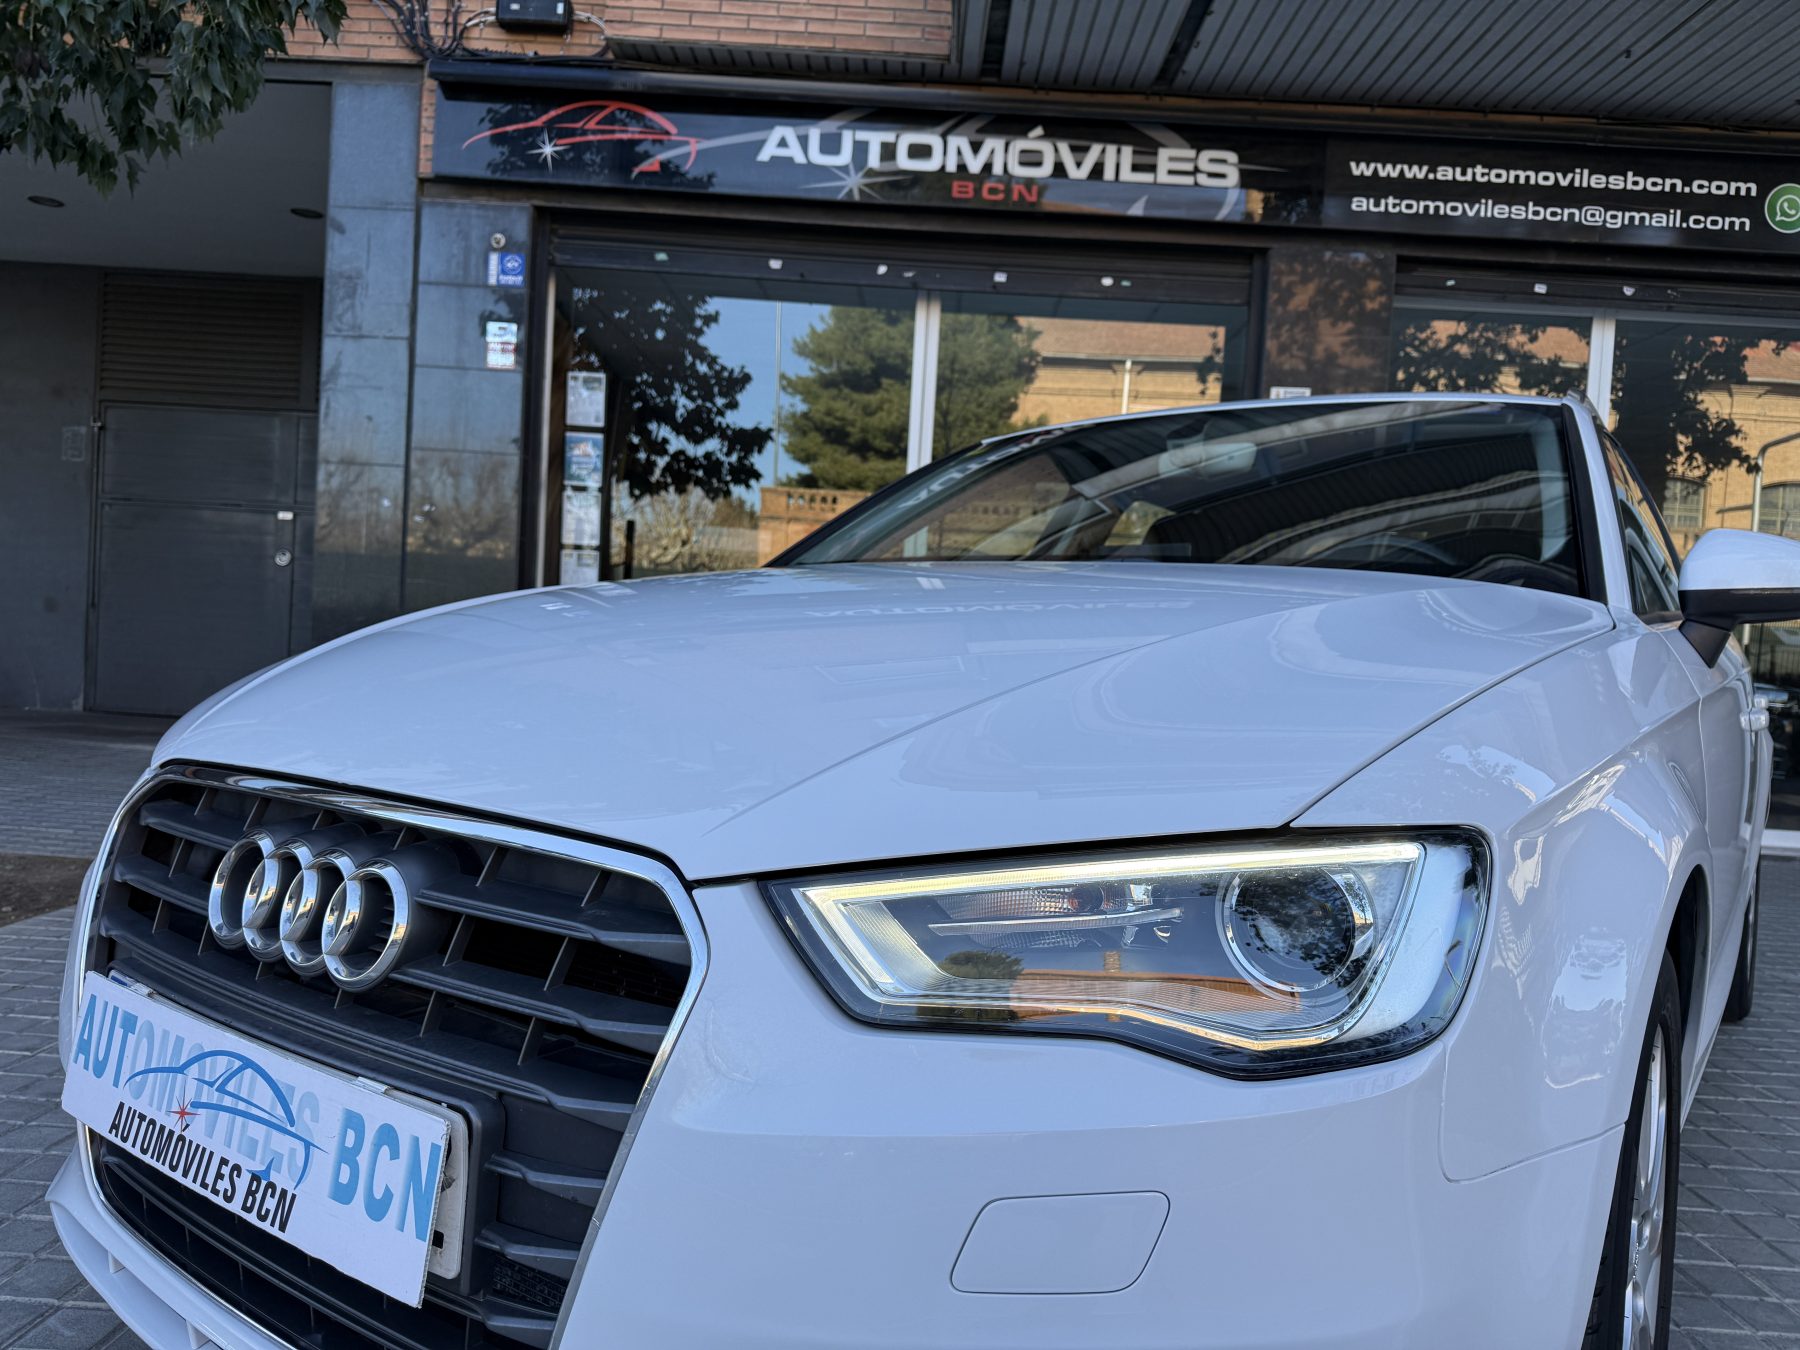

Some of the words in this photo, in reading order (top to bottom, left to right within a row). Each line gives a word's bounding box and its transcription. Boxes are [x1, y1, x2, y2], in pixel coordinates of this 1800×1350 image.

[756, 125, 1240, 188] AUTOMÓVILES
[1349, 161, 1757, 197] www.automovilesbcn.com
[951, 180, 1039, 203] BCN
[1350, 195, 1751, 232] automovilesbcn@gmail.com
[108, 1100, 242, 1204] AUTOMÓVILES
[240, 1172, 298, 1234] BCN
[327, 1106, 442, 1243] BCN
